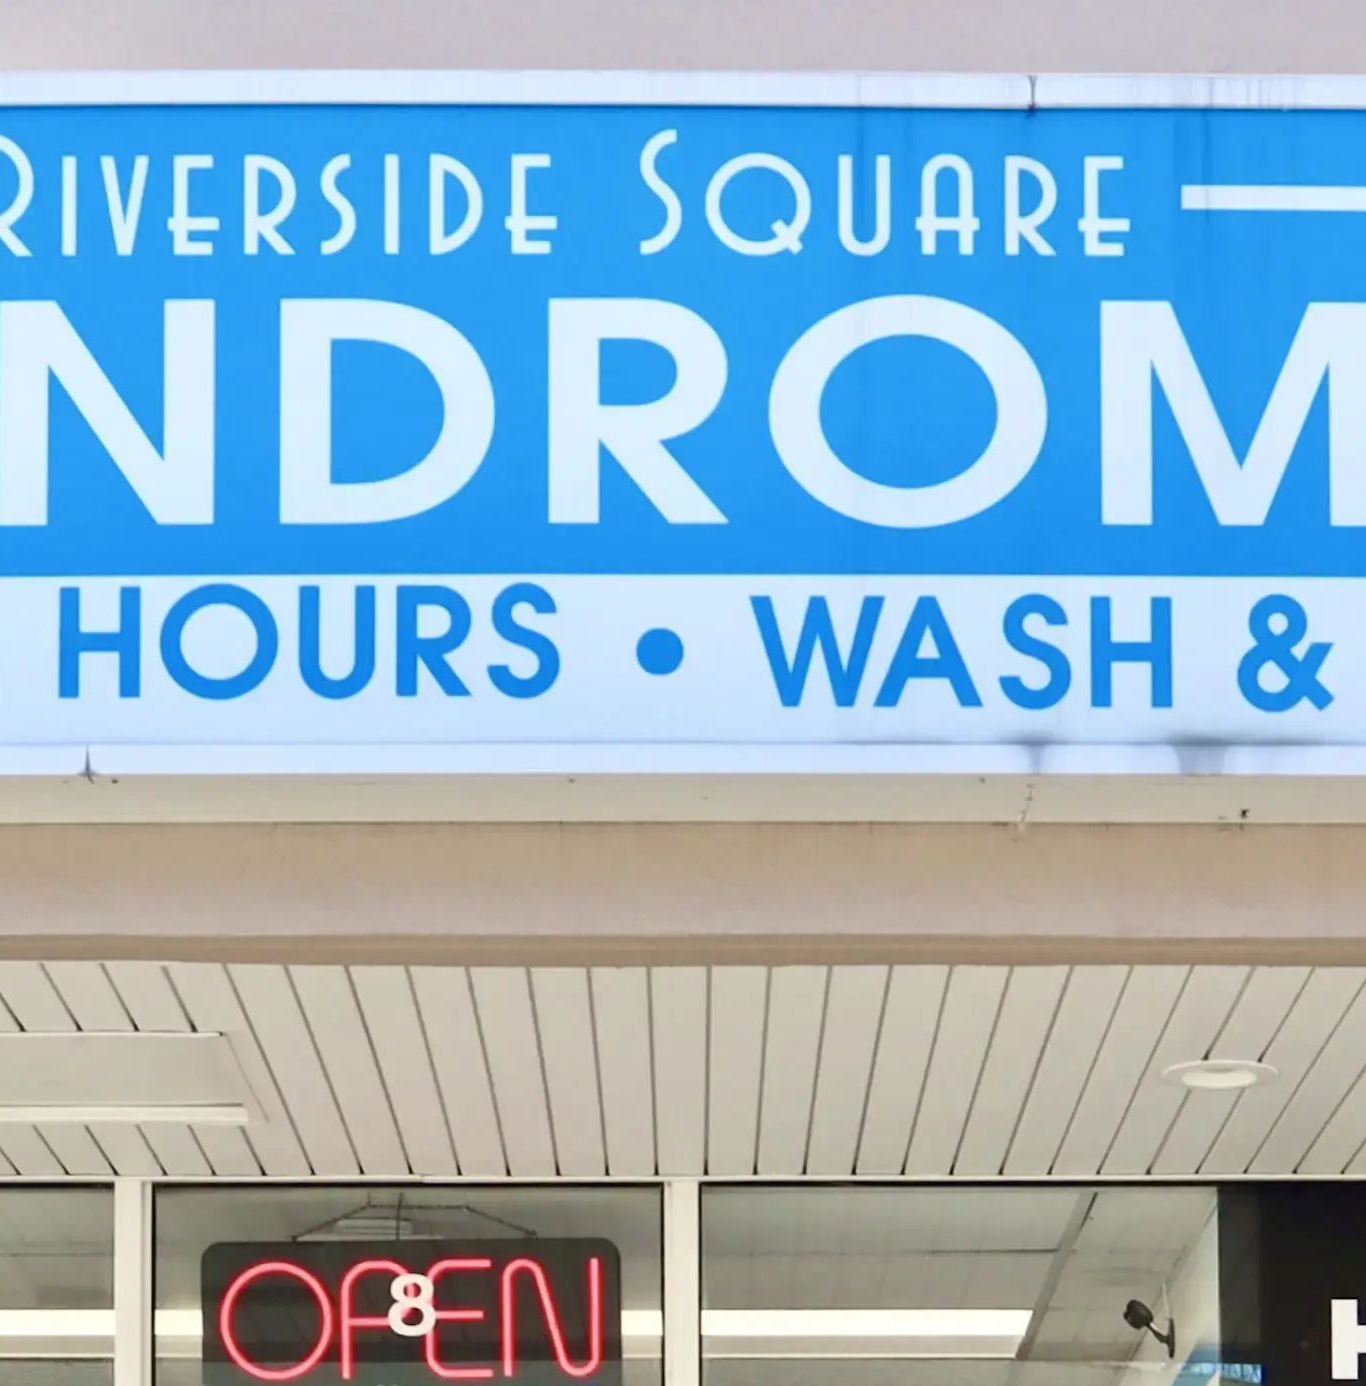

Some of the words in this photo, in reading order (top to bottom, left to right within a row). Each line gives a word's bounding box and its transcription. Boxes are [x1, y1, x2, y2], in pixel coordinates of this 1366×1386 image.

[59, 584, 561, 701] HOURS
[751, 594, 1174, 711] WASH
[1237, 593, 1334, 713] &
[219, 1257, 601, 1380] OPEN
[387, 1272, 437, 1337] 8
